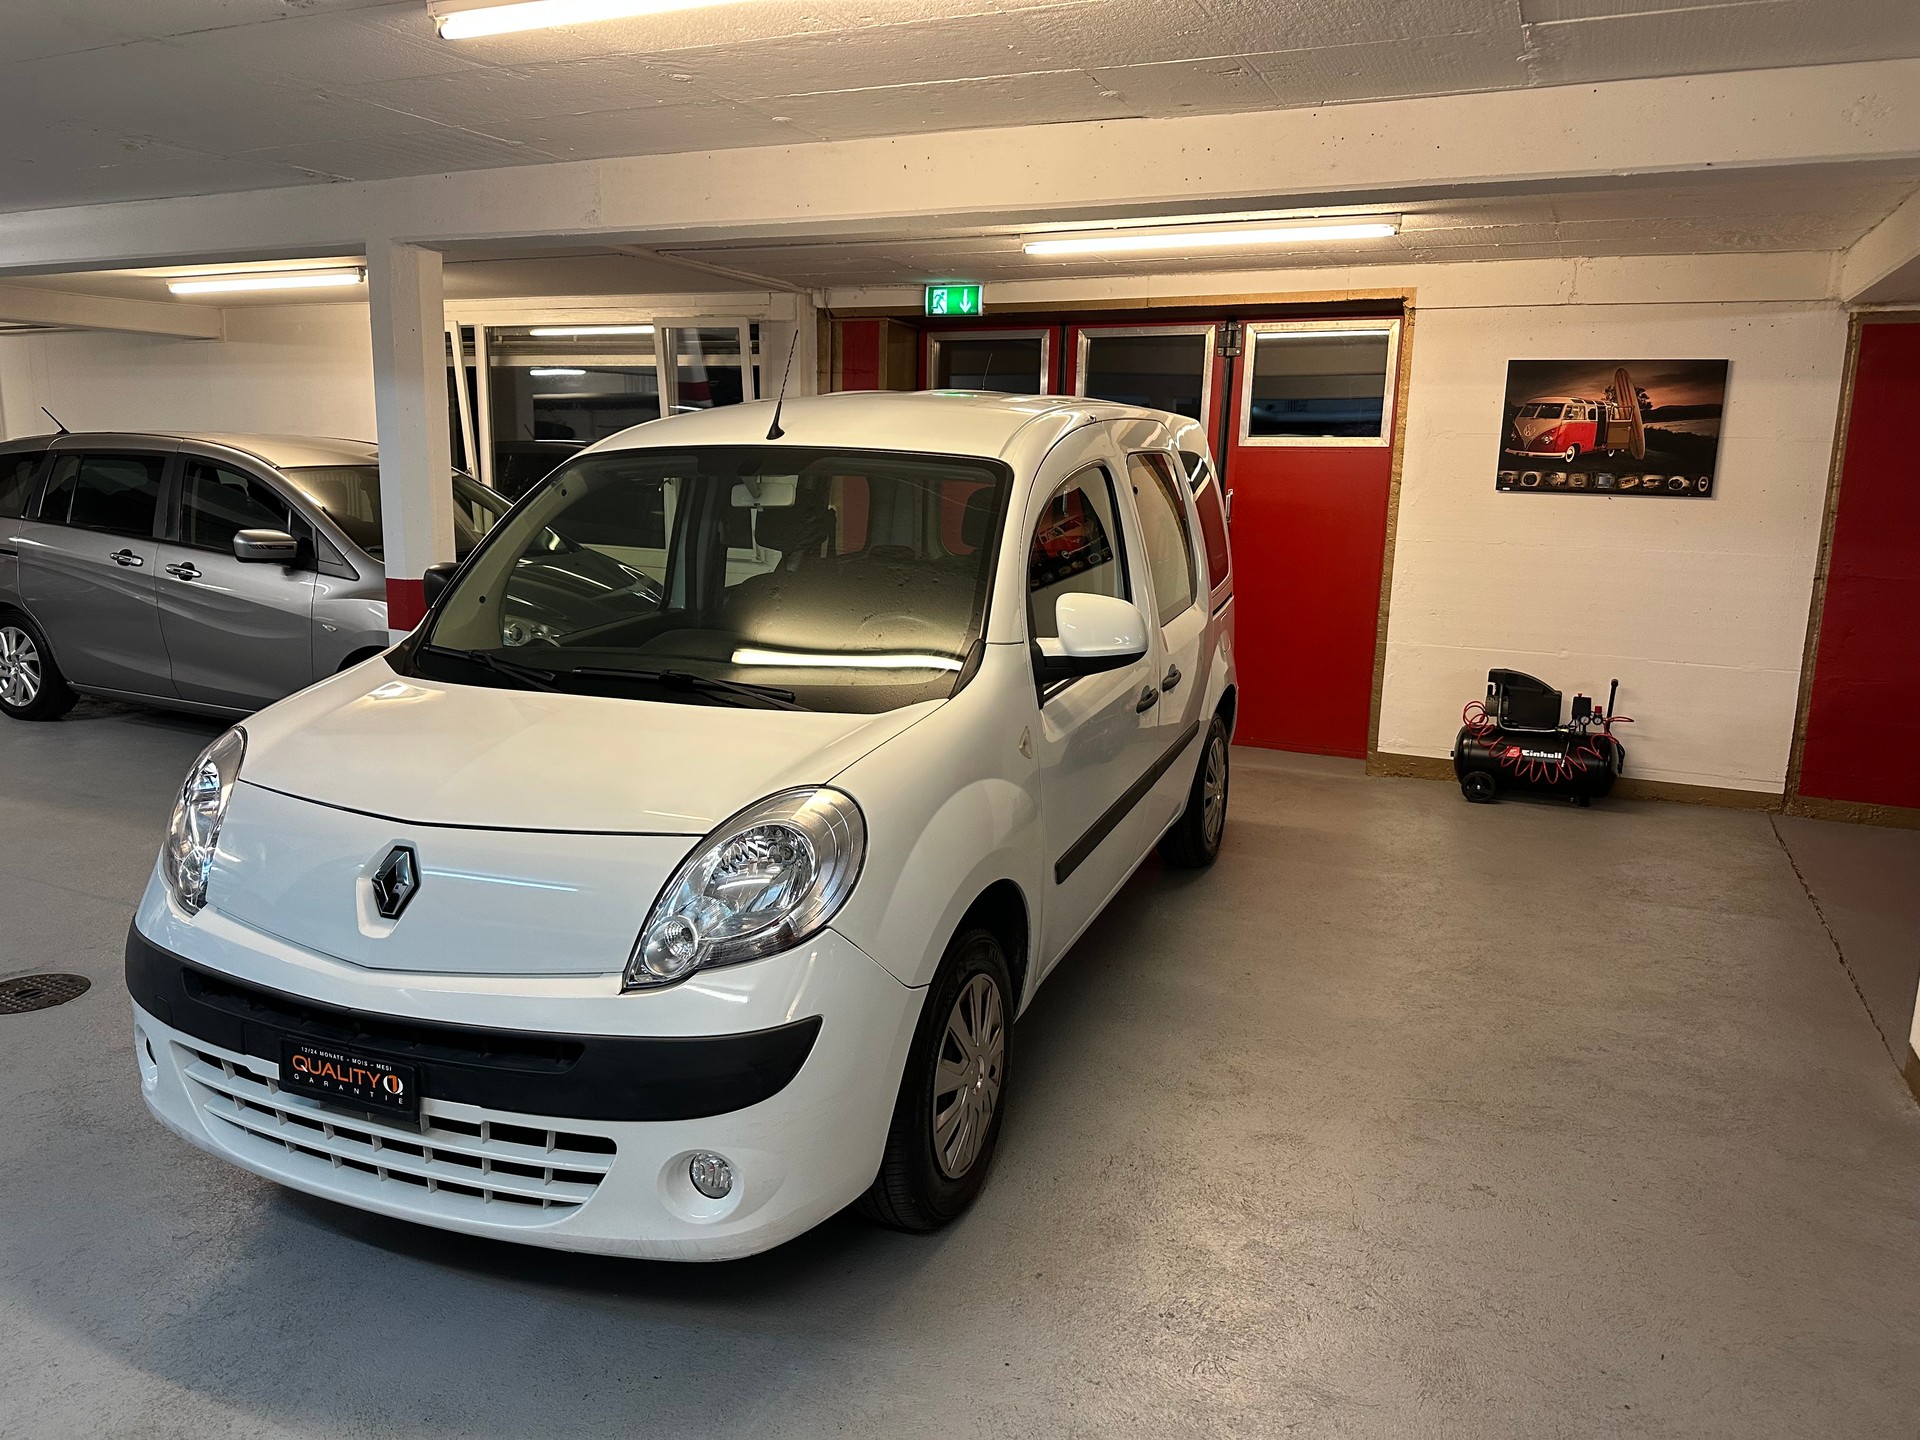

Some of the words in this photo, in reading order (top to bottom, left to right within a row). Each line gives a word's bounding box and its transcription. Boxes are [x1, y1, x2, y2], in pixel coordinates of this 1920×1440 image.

[292, 1055, 381, 1088] QUALITY
[301, 1046, 318, 1055] 12/24
[319, 1050, 344, 1062] MONATE
[351, 1058, 368, 1067] MOIS
[376, 1063, 392, 1072] MESI
[293, 1073, 403, 1104] GARANTIE
